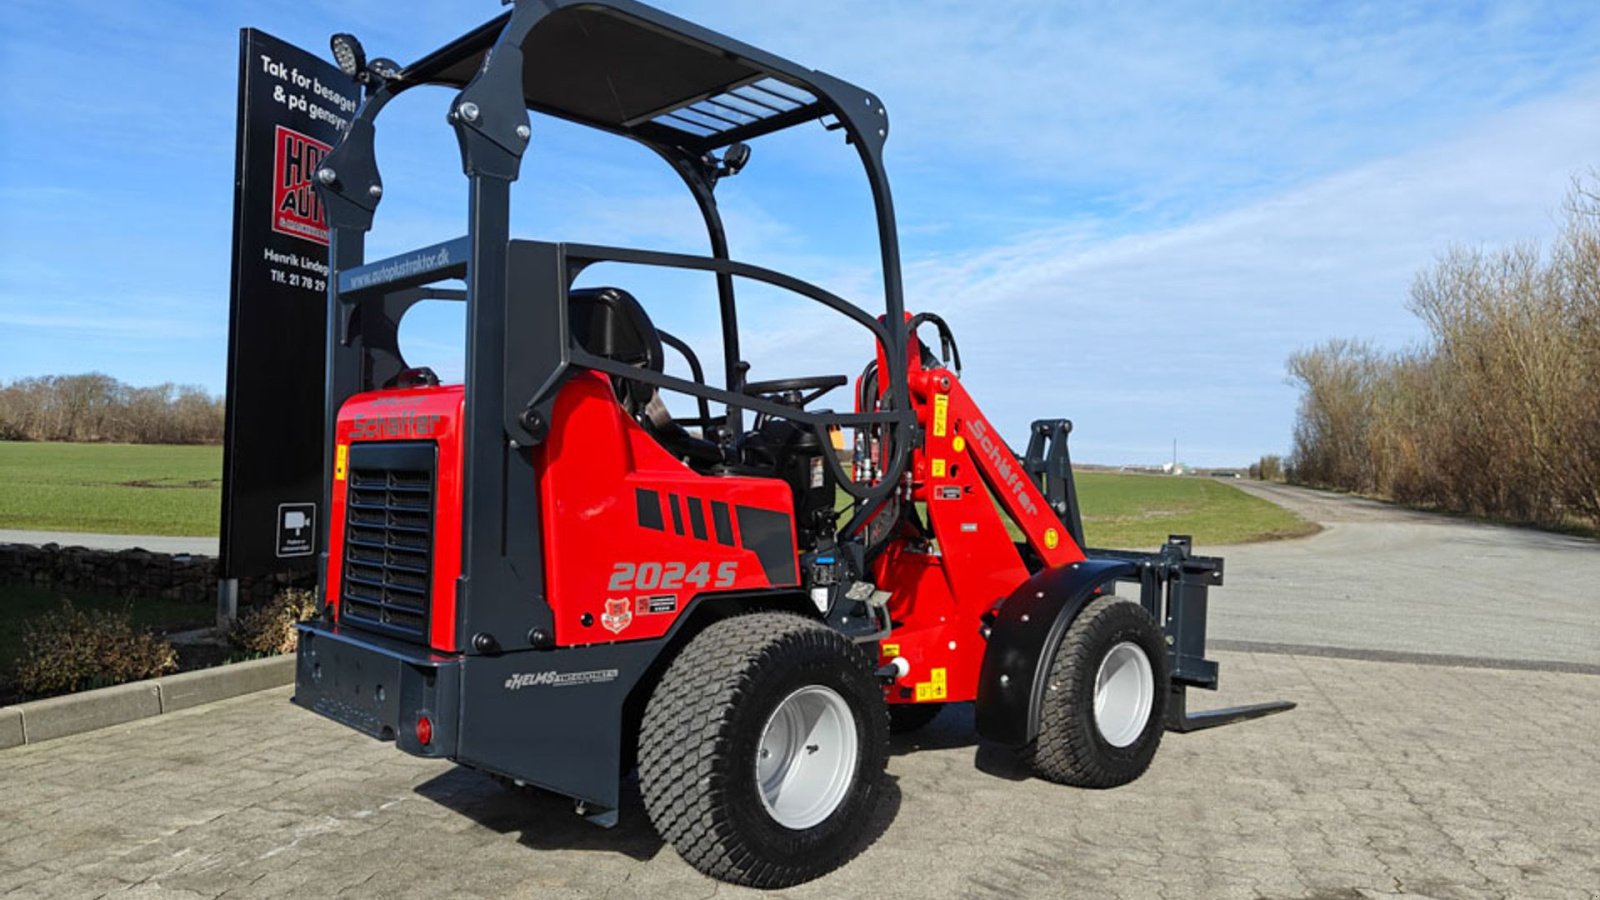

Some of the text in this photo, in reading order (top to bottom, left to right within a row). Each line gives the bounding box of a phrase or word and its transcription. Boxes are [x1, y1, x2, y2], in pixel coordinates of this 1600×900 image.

[260, 54, 288, 81] Tak
[291, 68, 312, 90] for
[273, 85, 286, 103] &
[288, 93, 307, 111] på
[283, 134, 328, 189] HO
[263, 247, 300, 267] Henrik
[350, 248, 450, 290] www.autoplustraktor.dk
[289, 273, 300, 287] 21
[301, 276, 314, 291] 78
[315, 278, 326, 292] 29
[966, 418, 1039, 516] Schäffer
[607, 561, 739, 592] 2024 S
